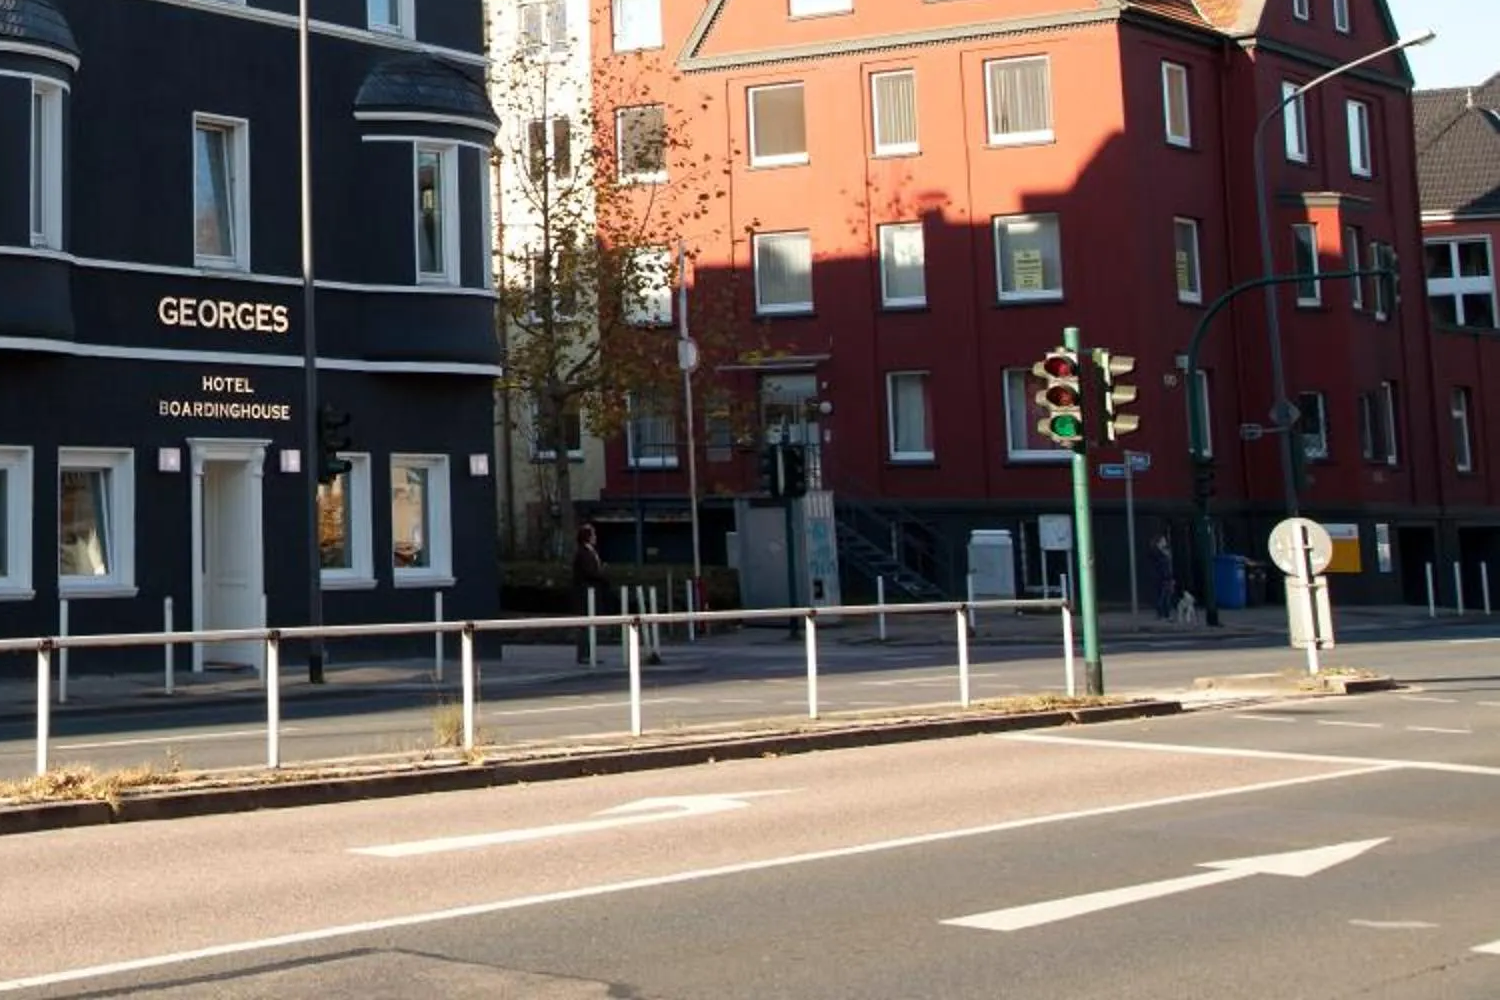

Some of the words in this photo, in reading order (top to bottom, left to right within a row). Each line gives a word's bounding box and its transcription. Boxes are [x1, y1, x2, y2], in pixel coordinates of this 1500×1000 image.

[158, 296, 289, 333] GEORGES
[202, 375, 254, 393] HOTEL
[159, 401, 291, 421] BOARDINGHOUSE
